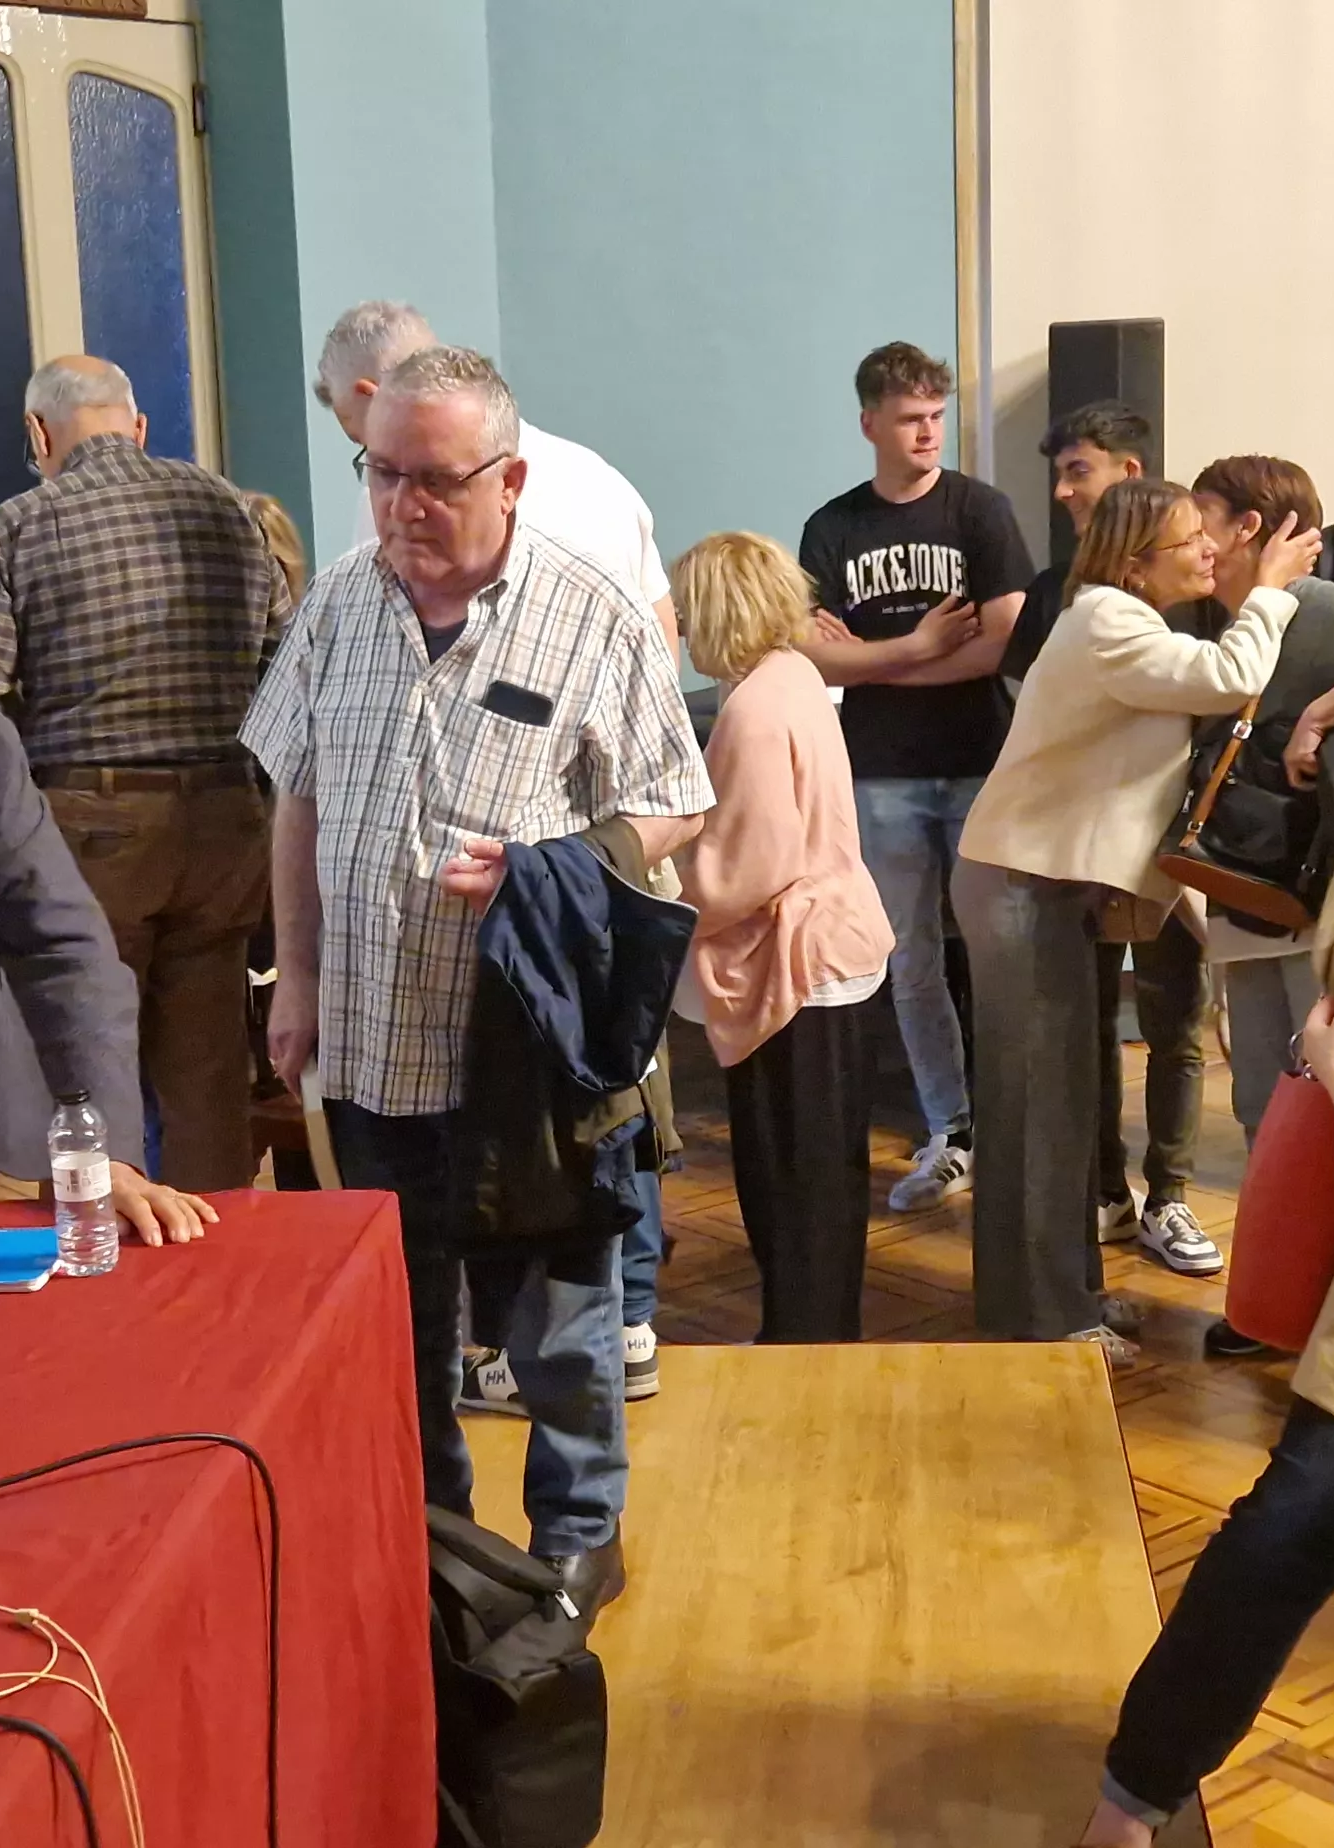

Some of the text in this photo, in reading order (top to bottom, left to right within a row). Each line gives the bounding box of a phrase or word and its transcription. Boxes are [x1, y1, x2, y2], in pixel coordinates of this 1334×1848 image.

[846, 543, 967, 611] ACK&JONE
[627, 1337, 648, 1350] HH
[485, 1369, 507, 1386] HH
